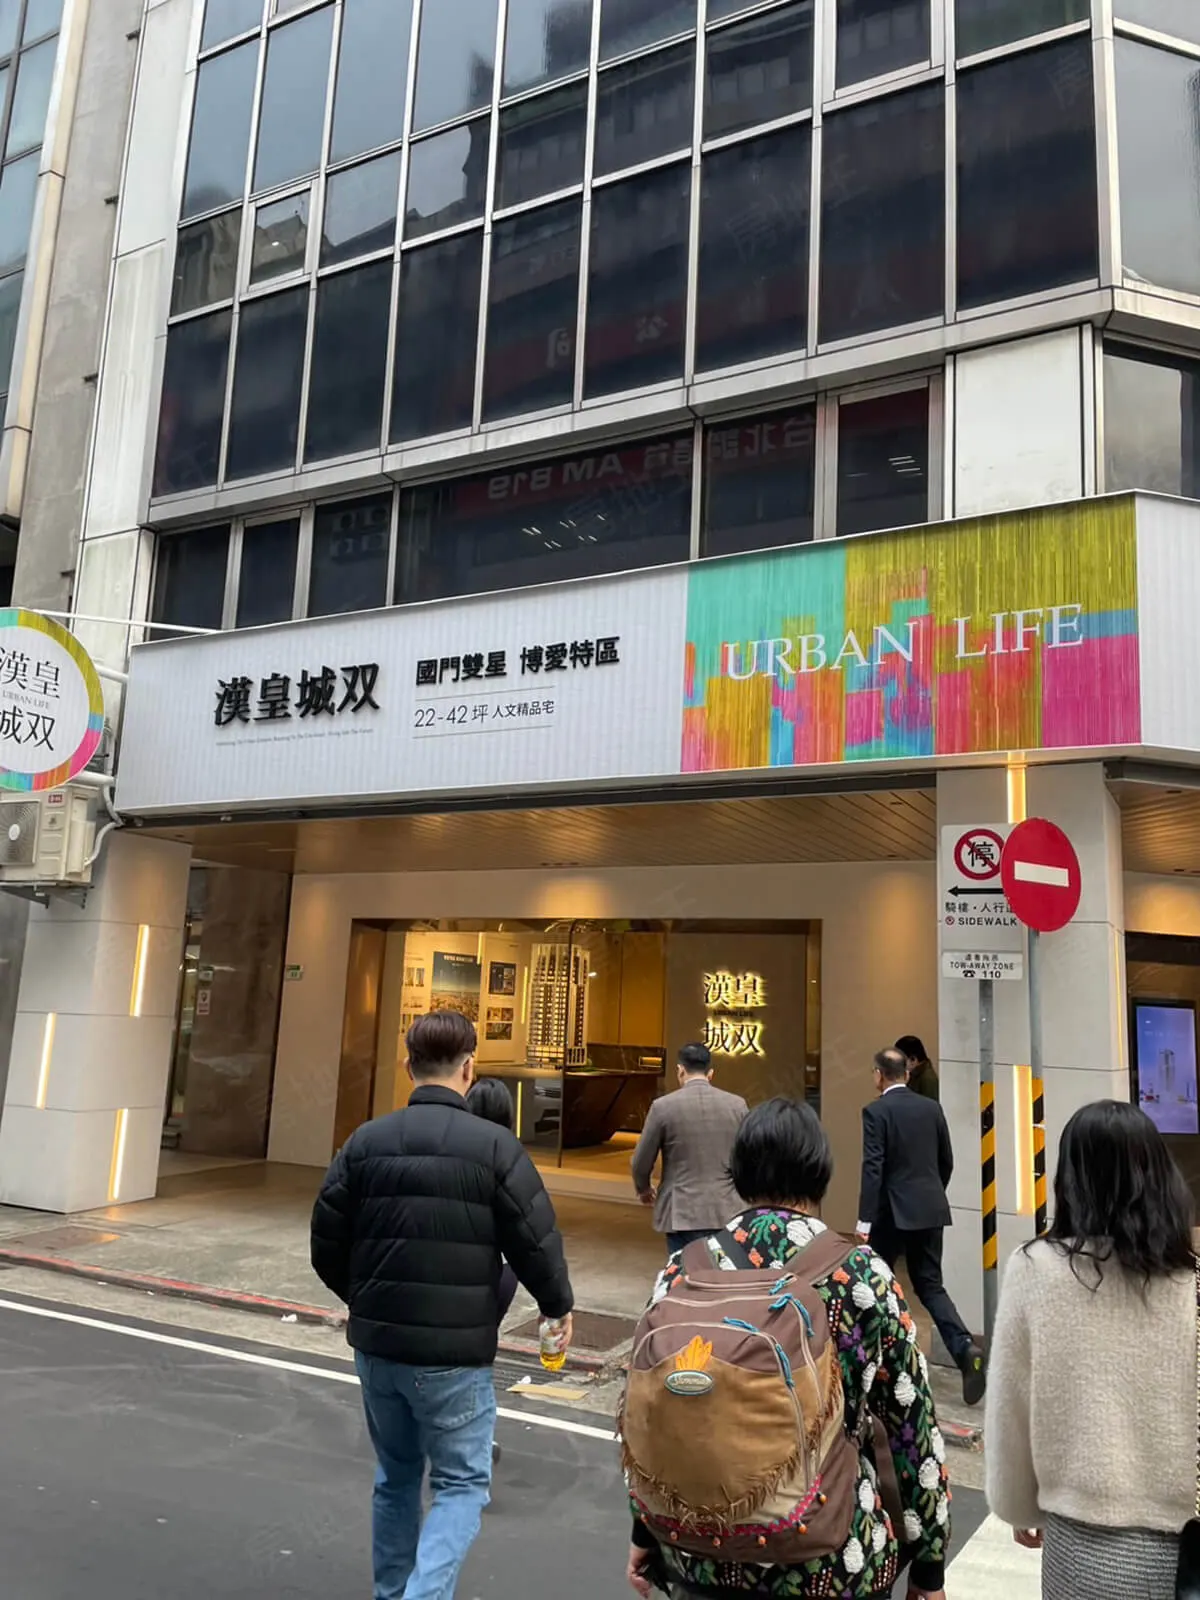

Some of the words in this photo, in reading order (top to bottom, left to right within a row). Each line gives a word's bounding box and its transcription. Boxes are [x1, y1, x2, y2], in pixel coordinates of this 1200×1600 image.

[724, 620, 919, 681] URBAN
[953, 603, 1084, 659] LIFE
[0, 647, 60, 700] 漢皇
[415, 650, 507, 687] 國門雙星
[520, 636, 620, 676] 博愛特區
[214, 662, 381, 726] 漢皇城双
[492, 699, 555, 720] 人文精品宅
[967, 841, 994, 868] 停
[958, 916, 1018, 927] SIDEWALK
[949, 961, 991, 970] TOW-AWAY
[993, 962, 1015, 970] ZONE
[982, 970, 1002, 979] 110
[702, 972, 764, 1006] 漢皇
[702, 1019, 762, 1054] 城双
